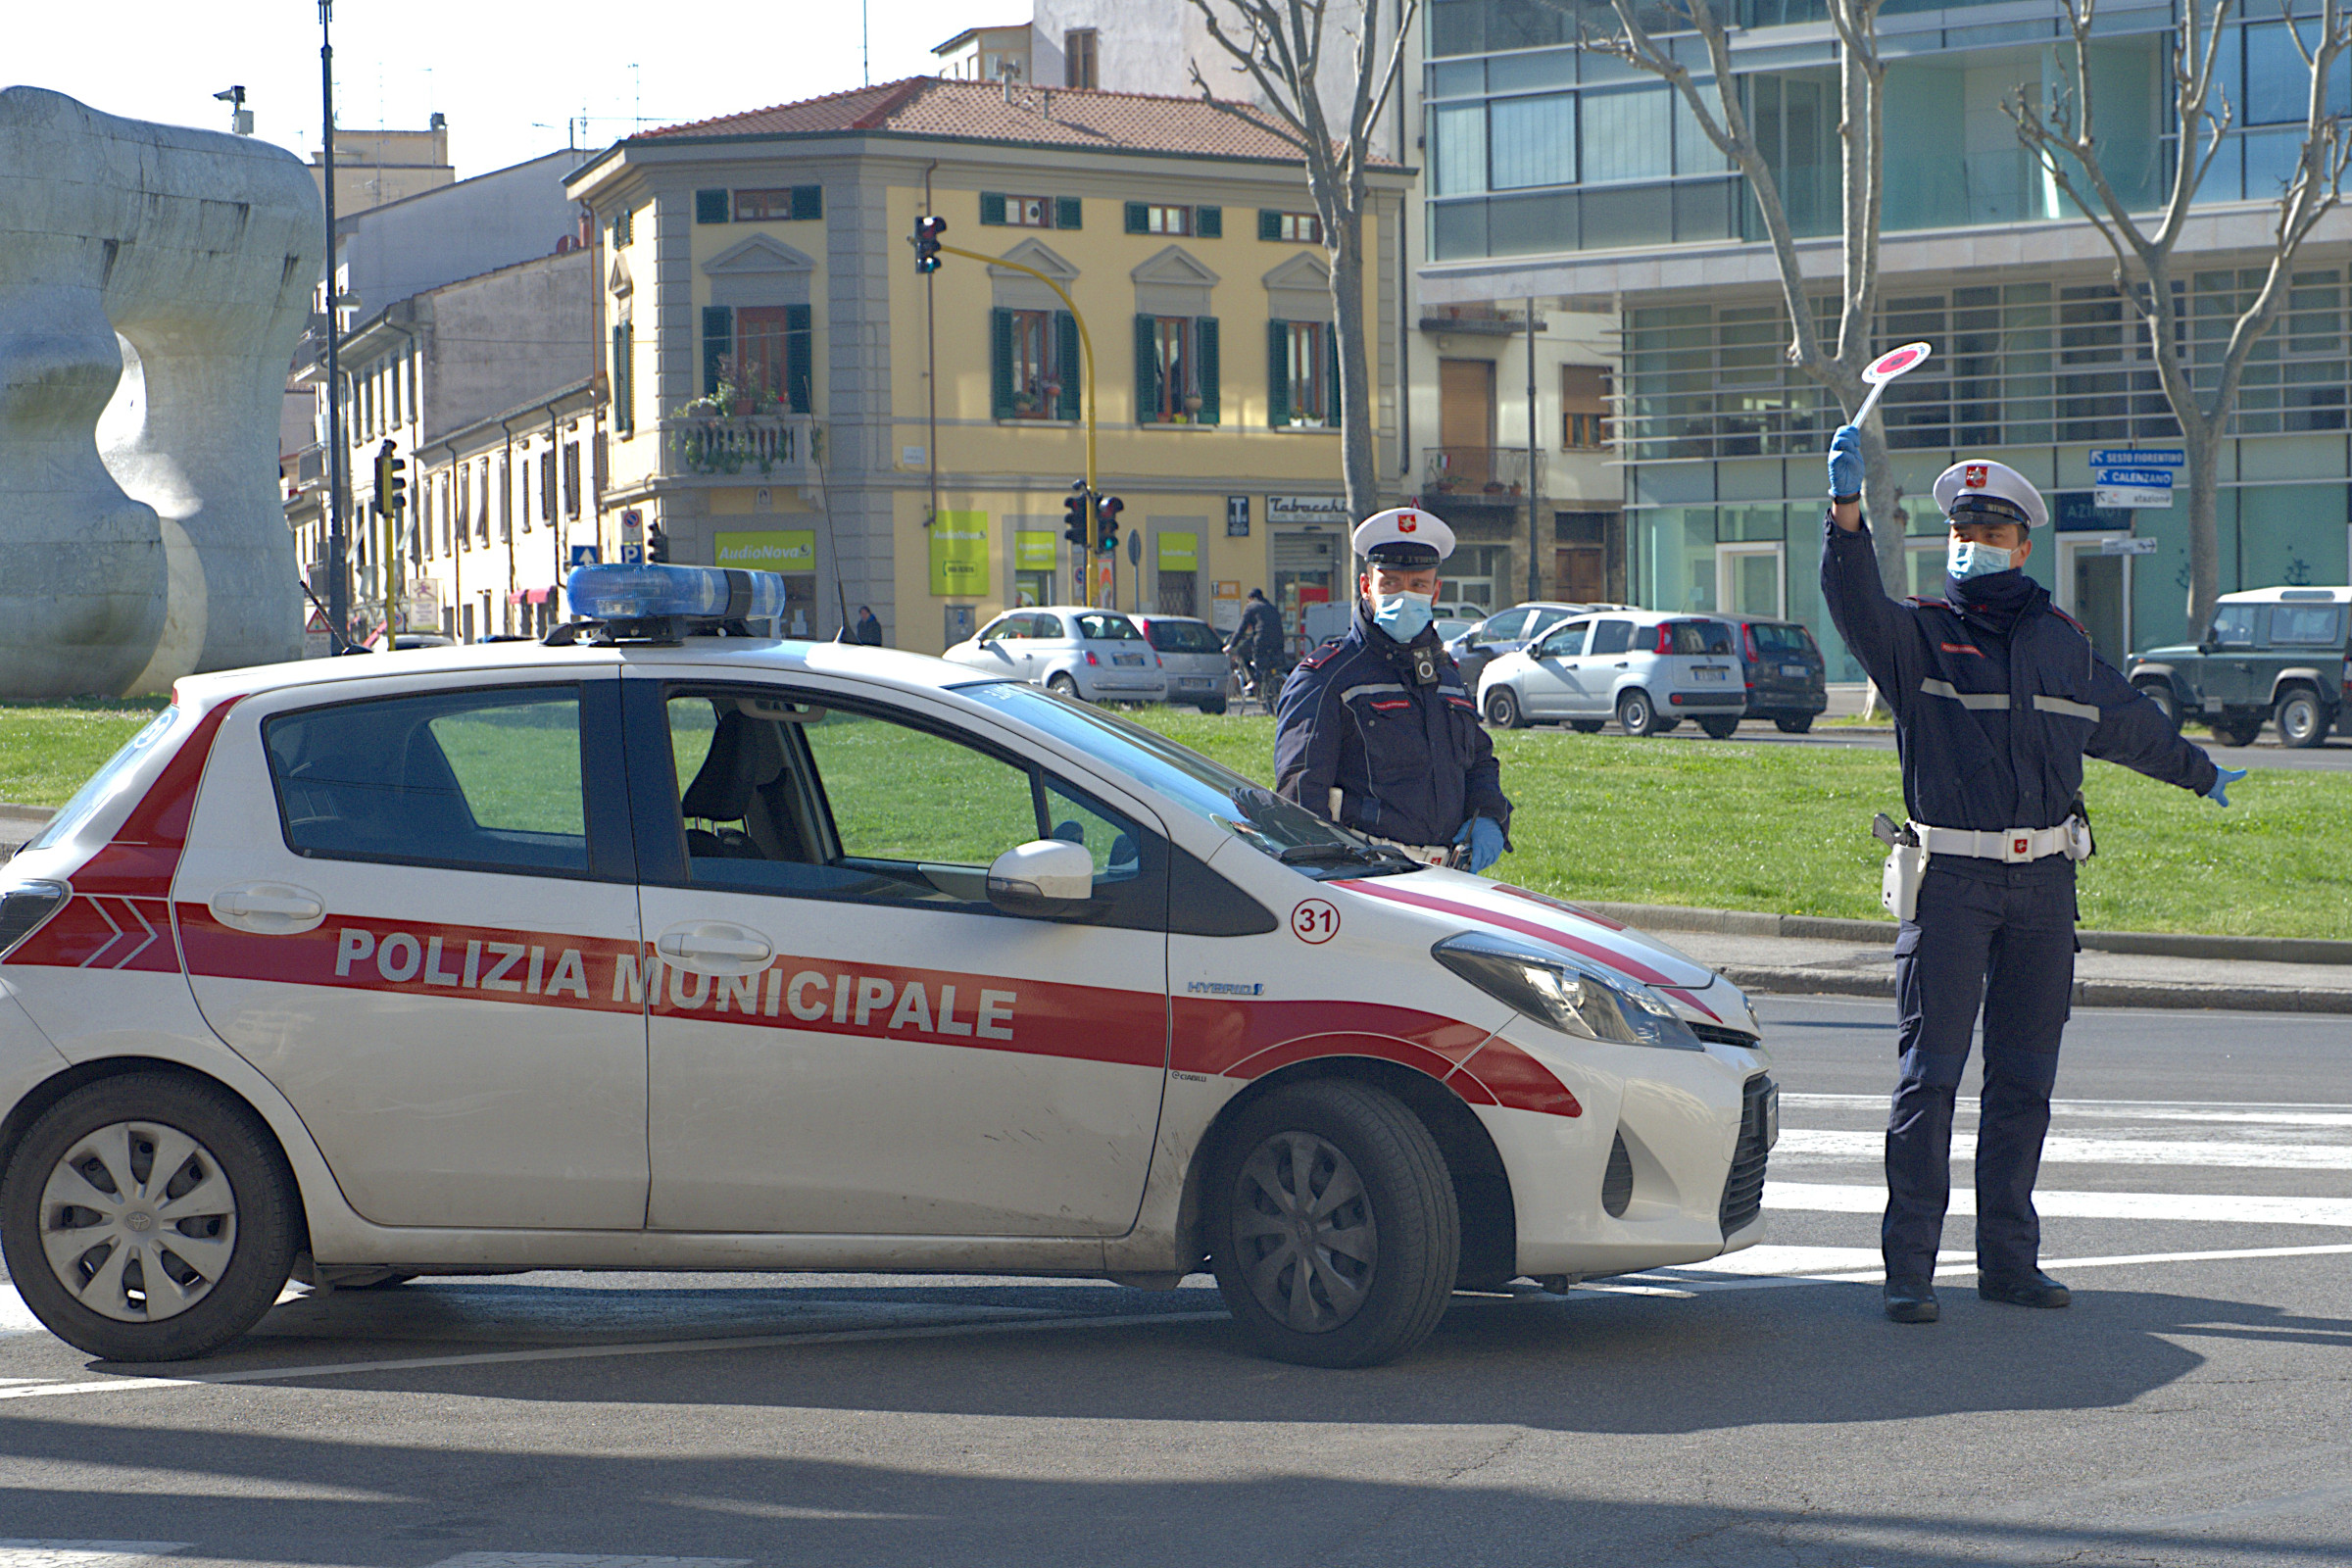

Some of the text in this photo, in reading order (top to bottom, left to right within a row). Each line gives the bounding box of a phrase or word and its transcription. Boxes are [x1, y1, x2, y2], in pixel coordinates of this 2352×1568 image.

[2106, 453, 2182, 464] SESTO FIORENTINO
[2112, 471, 2171, 484] CALENZANO
[1270, 498, 1348, 513] Tabacchi
[2133, 493, 2170, 503] stazione
[719, 545, 800, 561] AudioNova
[1298, 908, 1331, 932] 31
[334, 927, 1018, 1041] POLIZIA MUNICIPALE
[1188, 981, 1252, 996] HYBRID
